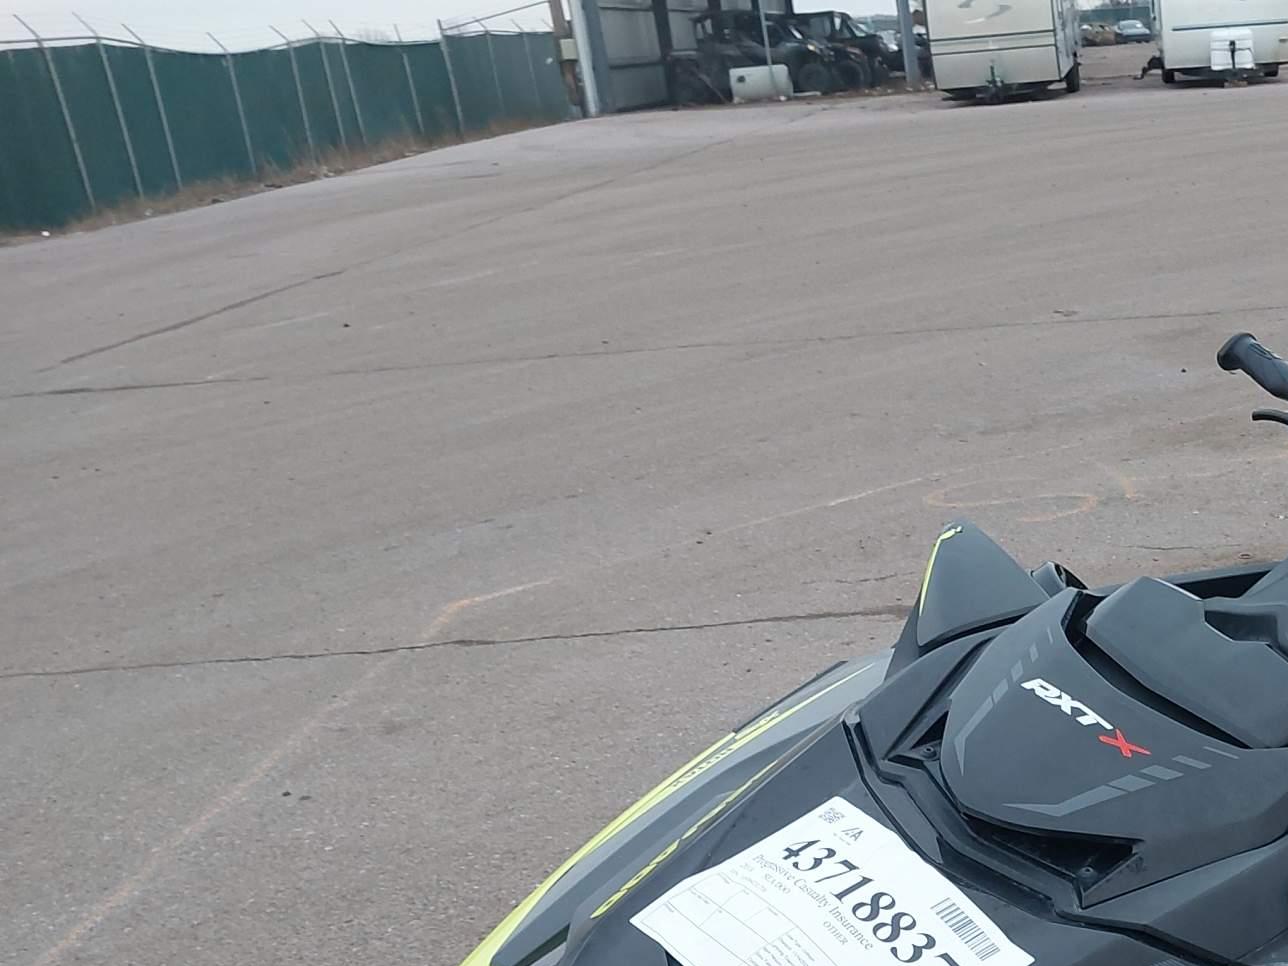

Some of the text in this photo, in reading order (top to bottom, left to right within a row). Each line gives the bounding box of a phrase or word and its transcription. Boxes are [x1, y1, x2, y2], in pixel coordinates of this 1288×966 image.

[1020, 678, 1114, 730] RXT
[793, 877, 831, 908] Casualty
[828, 905, 875, 952] Insurance
[822, 920, 850, 946] OTHER
